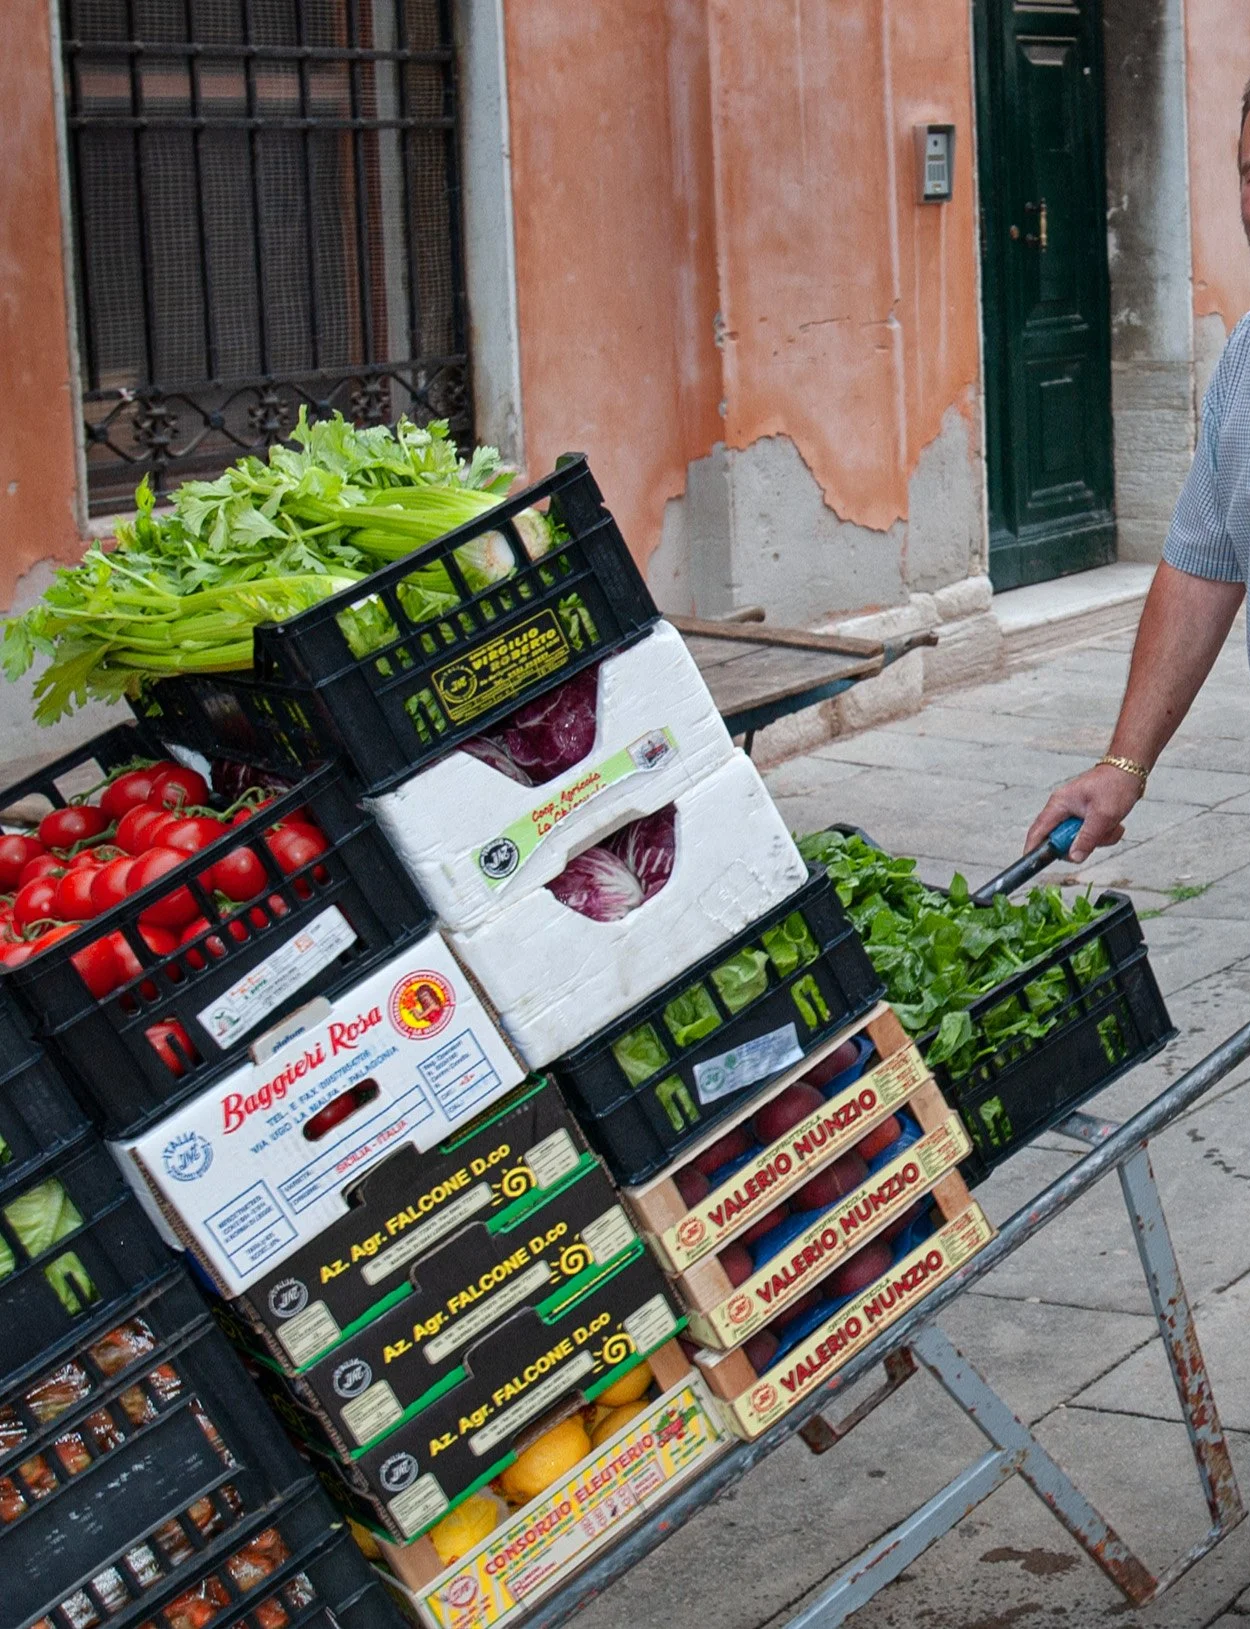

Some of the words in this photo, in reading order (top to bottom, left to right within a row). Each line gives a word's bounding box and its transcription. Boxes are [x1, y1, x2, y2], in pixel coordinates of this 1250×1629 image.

[471, 627, 539, 671] VIRGILIO
[489, 628, 557, 673] ROBERTO
[532, 802, 559, 823] Coop.
[560, 771, 601, 805] Agricola
[220, 1042, 326, 1135] Baggieri
[327, 1006, 382, 1056] Rosa
[348, 1046, 399, 1084] PALAGONIA
[298, 1089, 318, 1105] FAX
[335, 1148, 372, 1174] SICILIA
[376, 1121, 407, 1144] ITALIA
[708, 1153, 793, 1228] VALERIO
[793, 1087, 877, 1160] NUNZIO
[756, 1114, 821, 1167] ORTOFRUTTICOLA
[319, 1258, 350, 1285] Az.
[350, 1232, 388, 1263] Agr.
[384, 1168, 473, 1237] FALCONE
[469, 1143, 512, 1176] D.co
[756, 1228, 837, 1303] VALERIO
[839, 1162, 921, 1236] NUNZIO
[804, 1190, 868, 1245] ORTOFRUTTICOLA
[382, 1336, 413, 1364] Az.
[412, 1311, 450, 1343] Agr.
[447, 1247, 532, 1314] FALCONE
[528, 1221, 569, 1255] D.co
[780, 1315, 862, 1392] VALERIO
[863, 1249, 944, 1323] NUNZIO
[827, 1277, 891, 1334] ORTOFRUTTICOLA
[428, 1430, 459, 1458] Az.
[458, 1404, 494, 1435] Agr.
[491, 1340, 577, 1407] FALCONE
[572, 1311, 611, 1345] D.co
[485, 1500, 572, 1576] CONSORZIO
[574, 1433, 655, 1505] ELEUTERIO
